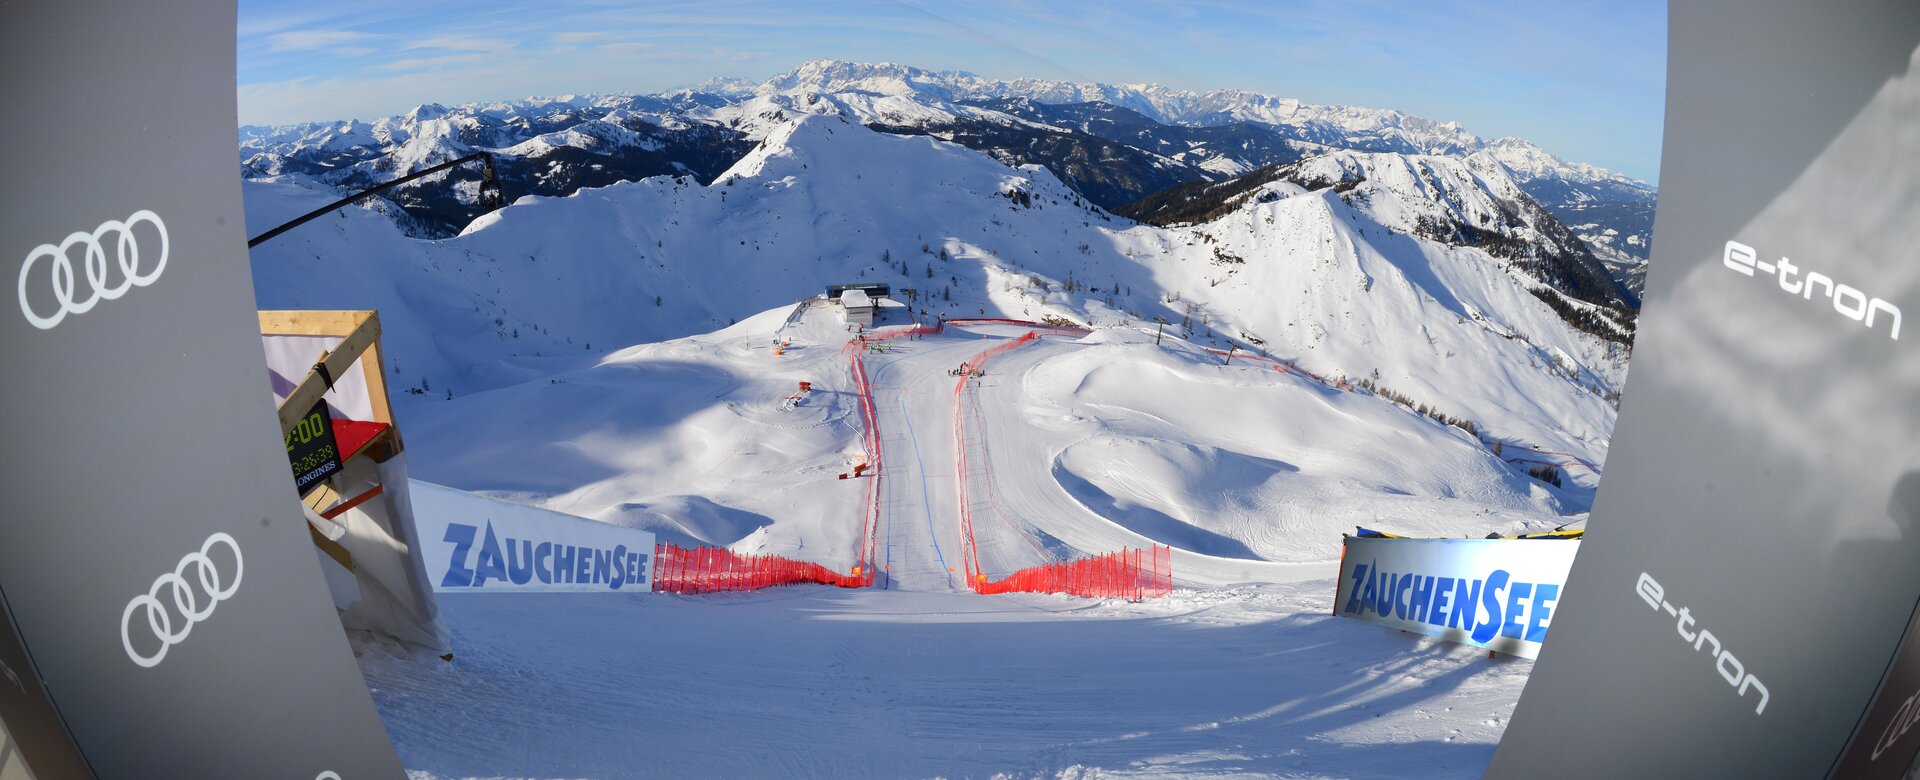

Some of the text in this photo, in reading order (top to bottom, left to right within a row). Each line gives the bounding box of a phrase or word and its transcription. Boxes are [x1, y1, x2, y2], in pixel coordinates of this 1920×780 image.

[1723, 240, 1902, 341] e-tron
[297, 461, 336, 488] ONGINES
[441, 518, 648, 590] ZAUCHENSEE
[1344, 557, 1559, 644] ZAUCHENSEE
[1635, 571, 1770, 716] e-tron
